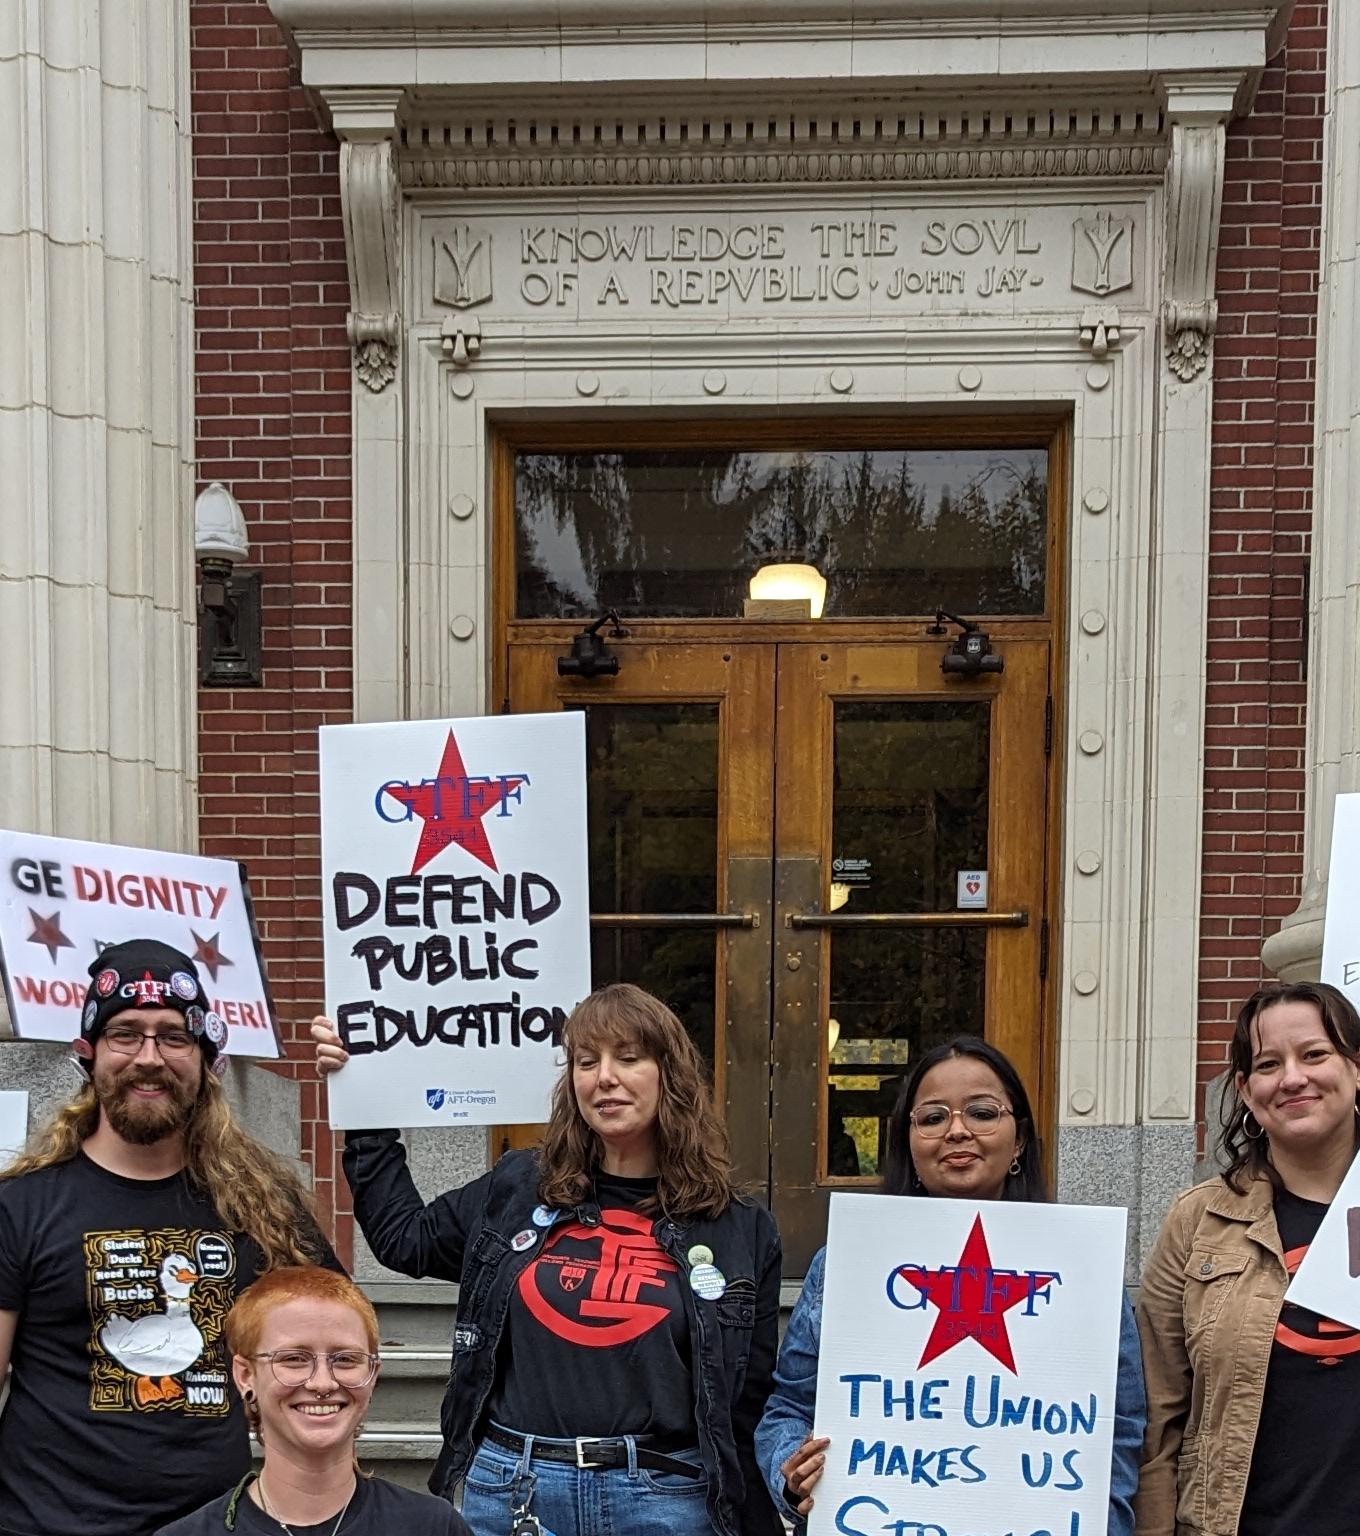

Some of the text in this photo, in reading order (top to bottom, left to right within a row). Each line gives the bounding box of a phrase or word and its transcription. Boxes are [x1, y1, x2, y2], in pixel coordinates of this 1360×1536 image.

[521, 222, 785, 263] KNOWLEDGE
[811, 221, 897, 257] THE
[521, 271, 579, 305] OF
[598, 270, 628, 304] A
[375, 774, 531, 823] GTFF
[73, 866, 227, 920] DIGNITY
[333, 871, 561, 931] DEFEND
[104, 1240, 146, 1251] Student
[110, 1254, 143, 1265] Ducks
[104, 1284, 155, 1301] Bucks
[128, 1268, 157, 1279] More
[886, 1263, 1063, 1317] GTFF
[187, 1386, 224, 1405] NOW
[839, 1374, 950, 1421] THE
[847, 1439, 1084, 1491] MAKES US
